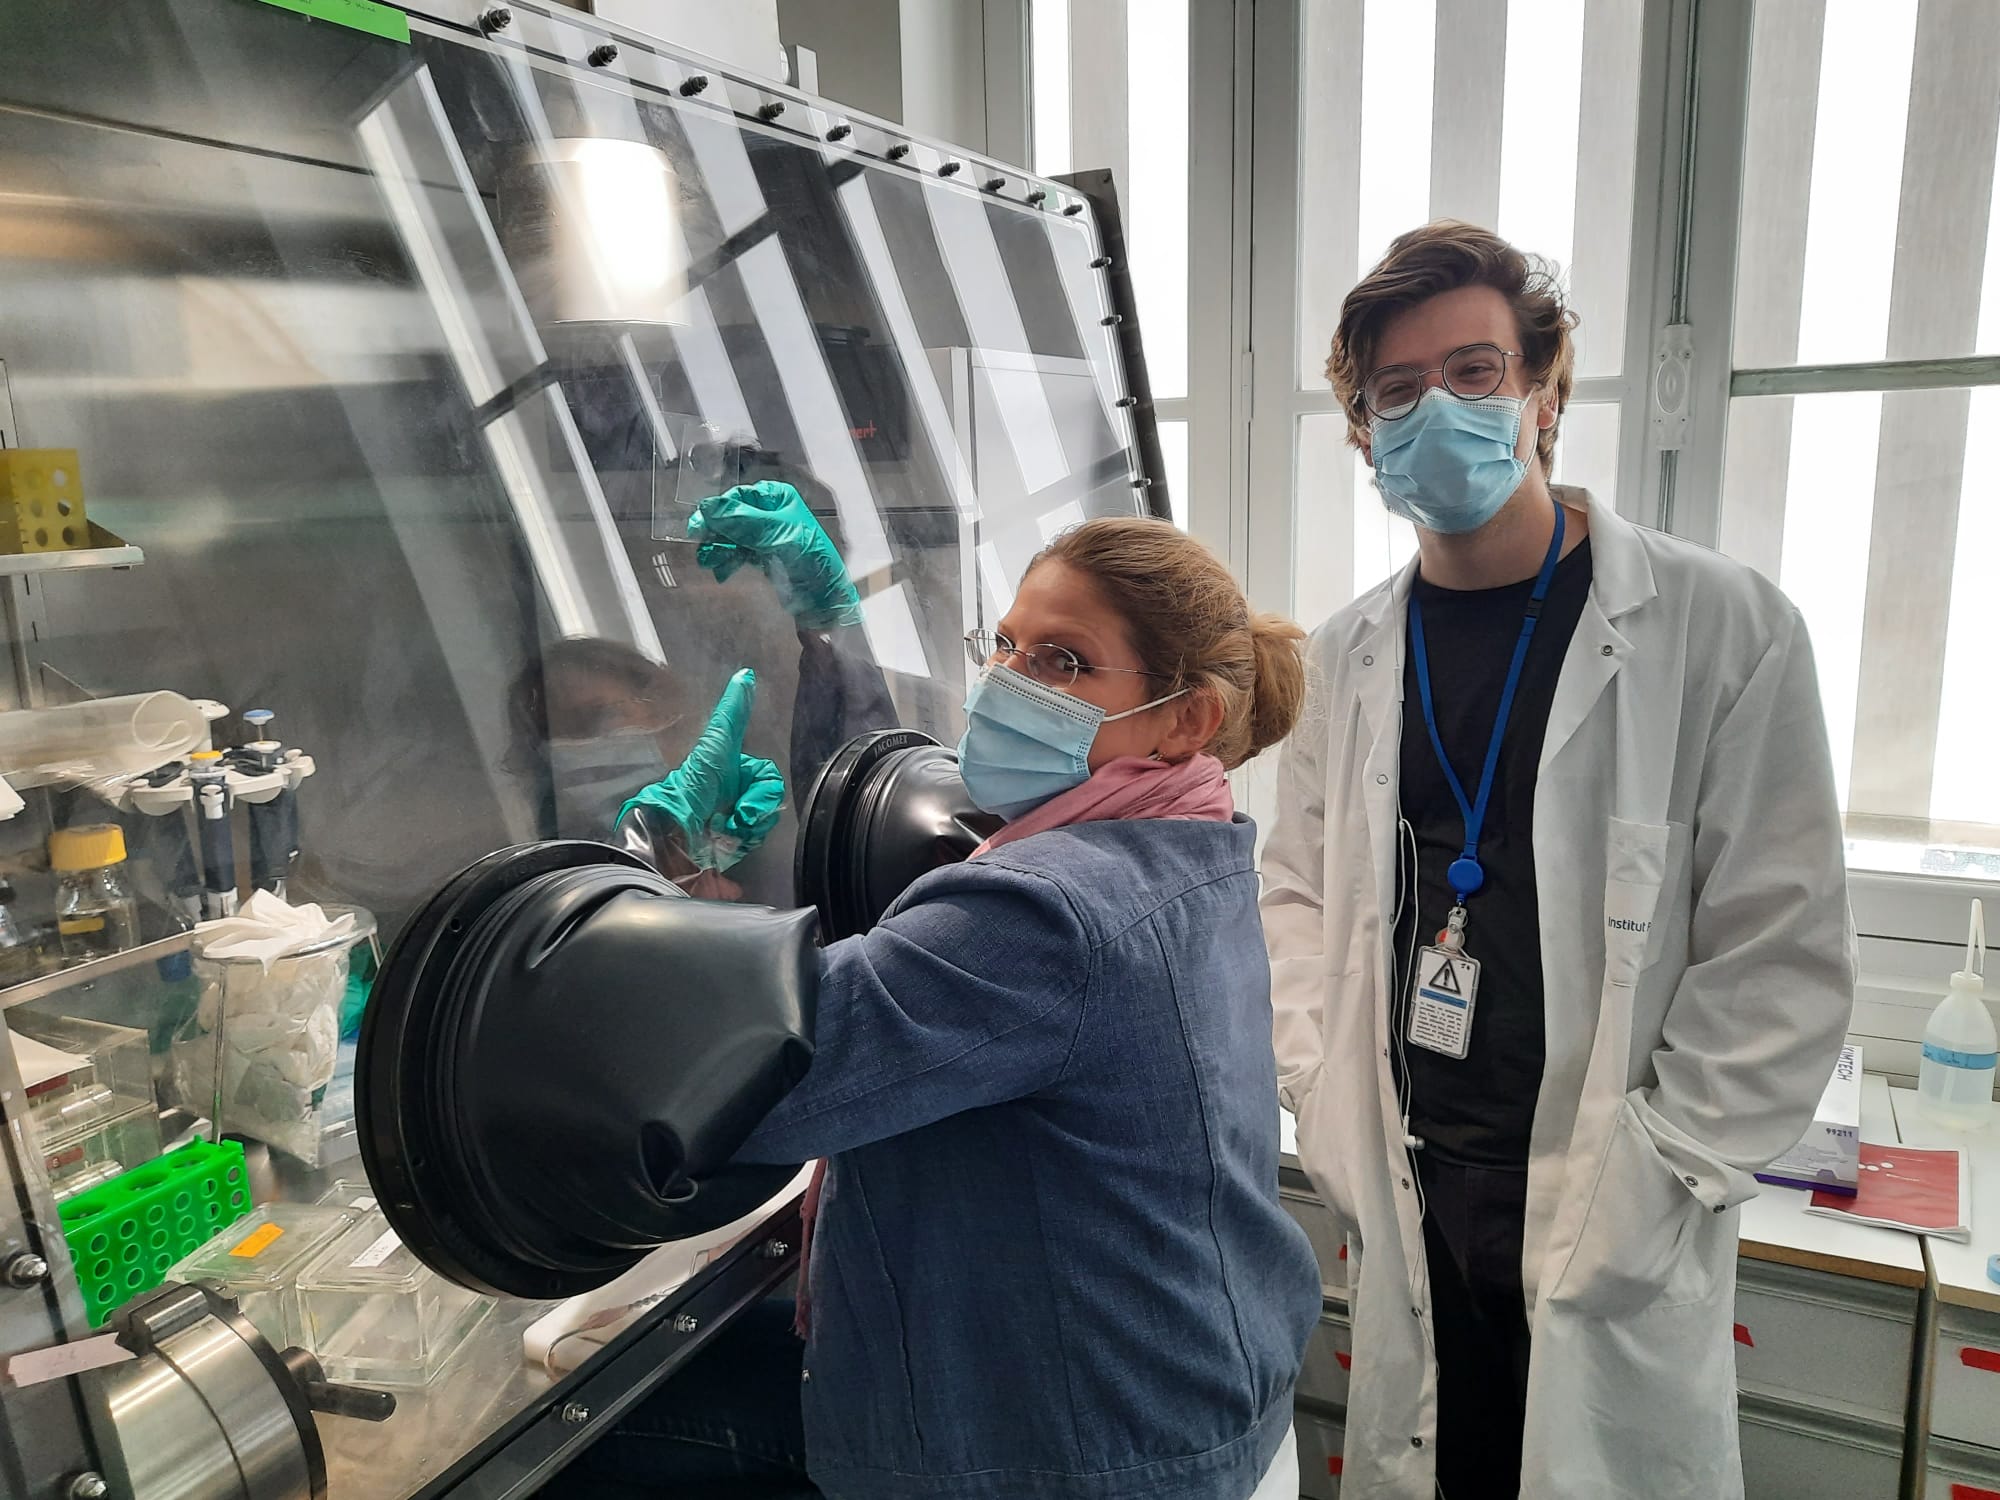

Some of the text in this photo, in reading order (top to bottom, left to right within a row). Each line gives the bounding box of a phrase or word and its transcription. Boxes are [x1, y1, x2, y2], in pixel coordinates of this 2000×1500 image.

[1608, 916, 1645, 932] Institut
[1837, 1046, 1855, 1082] KIMTECH
[1825, 1127, 1853, 1138] 99211
